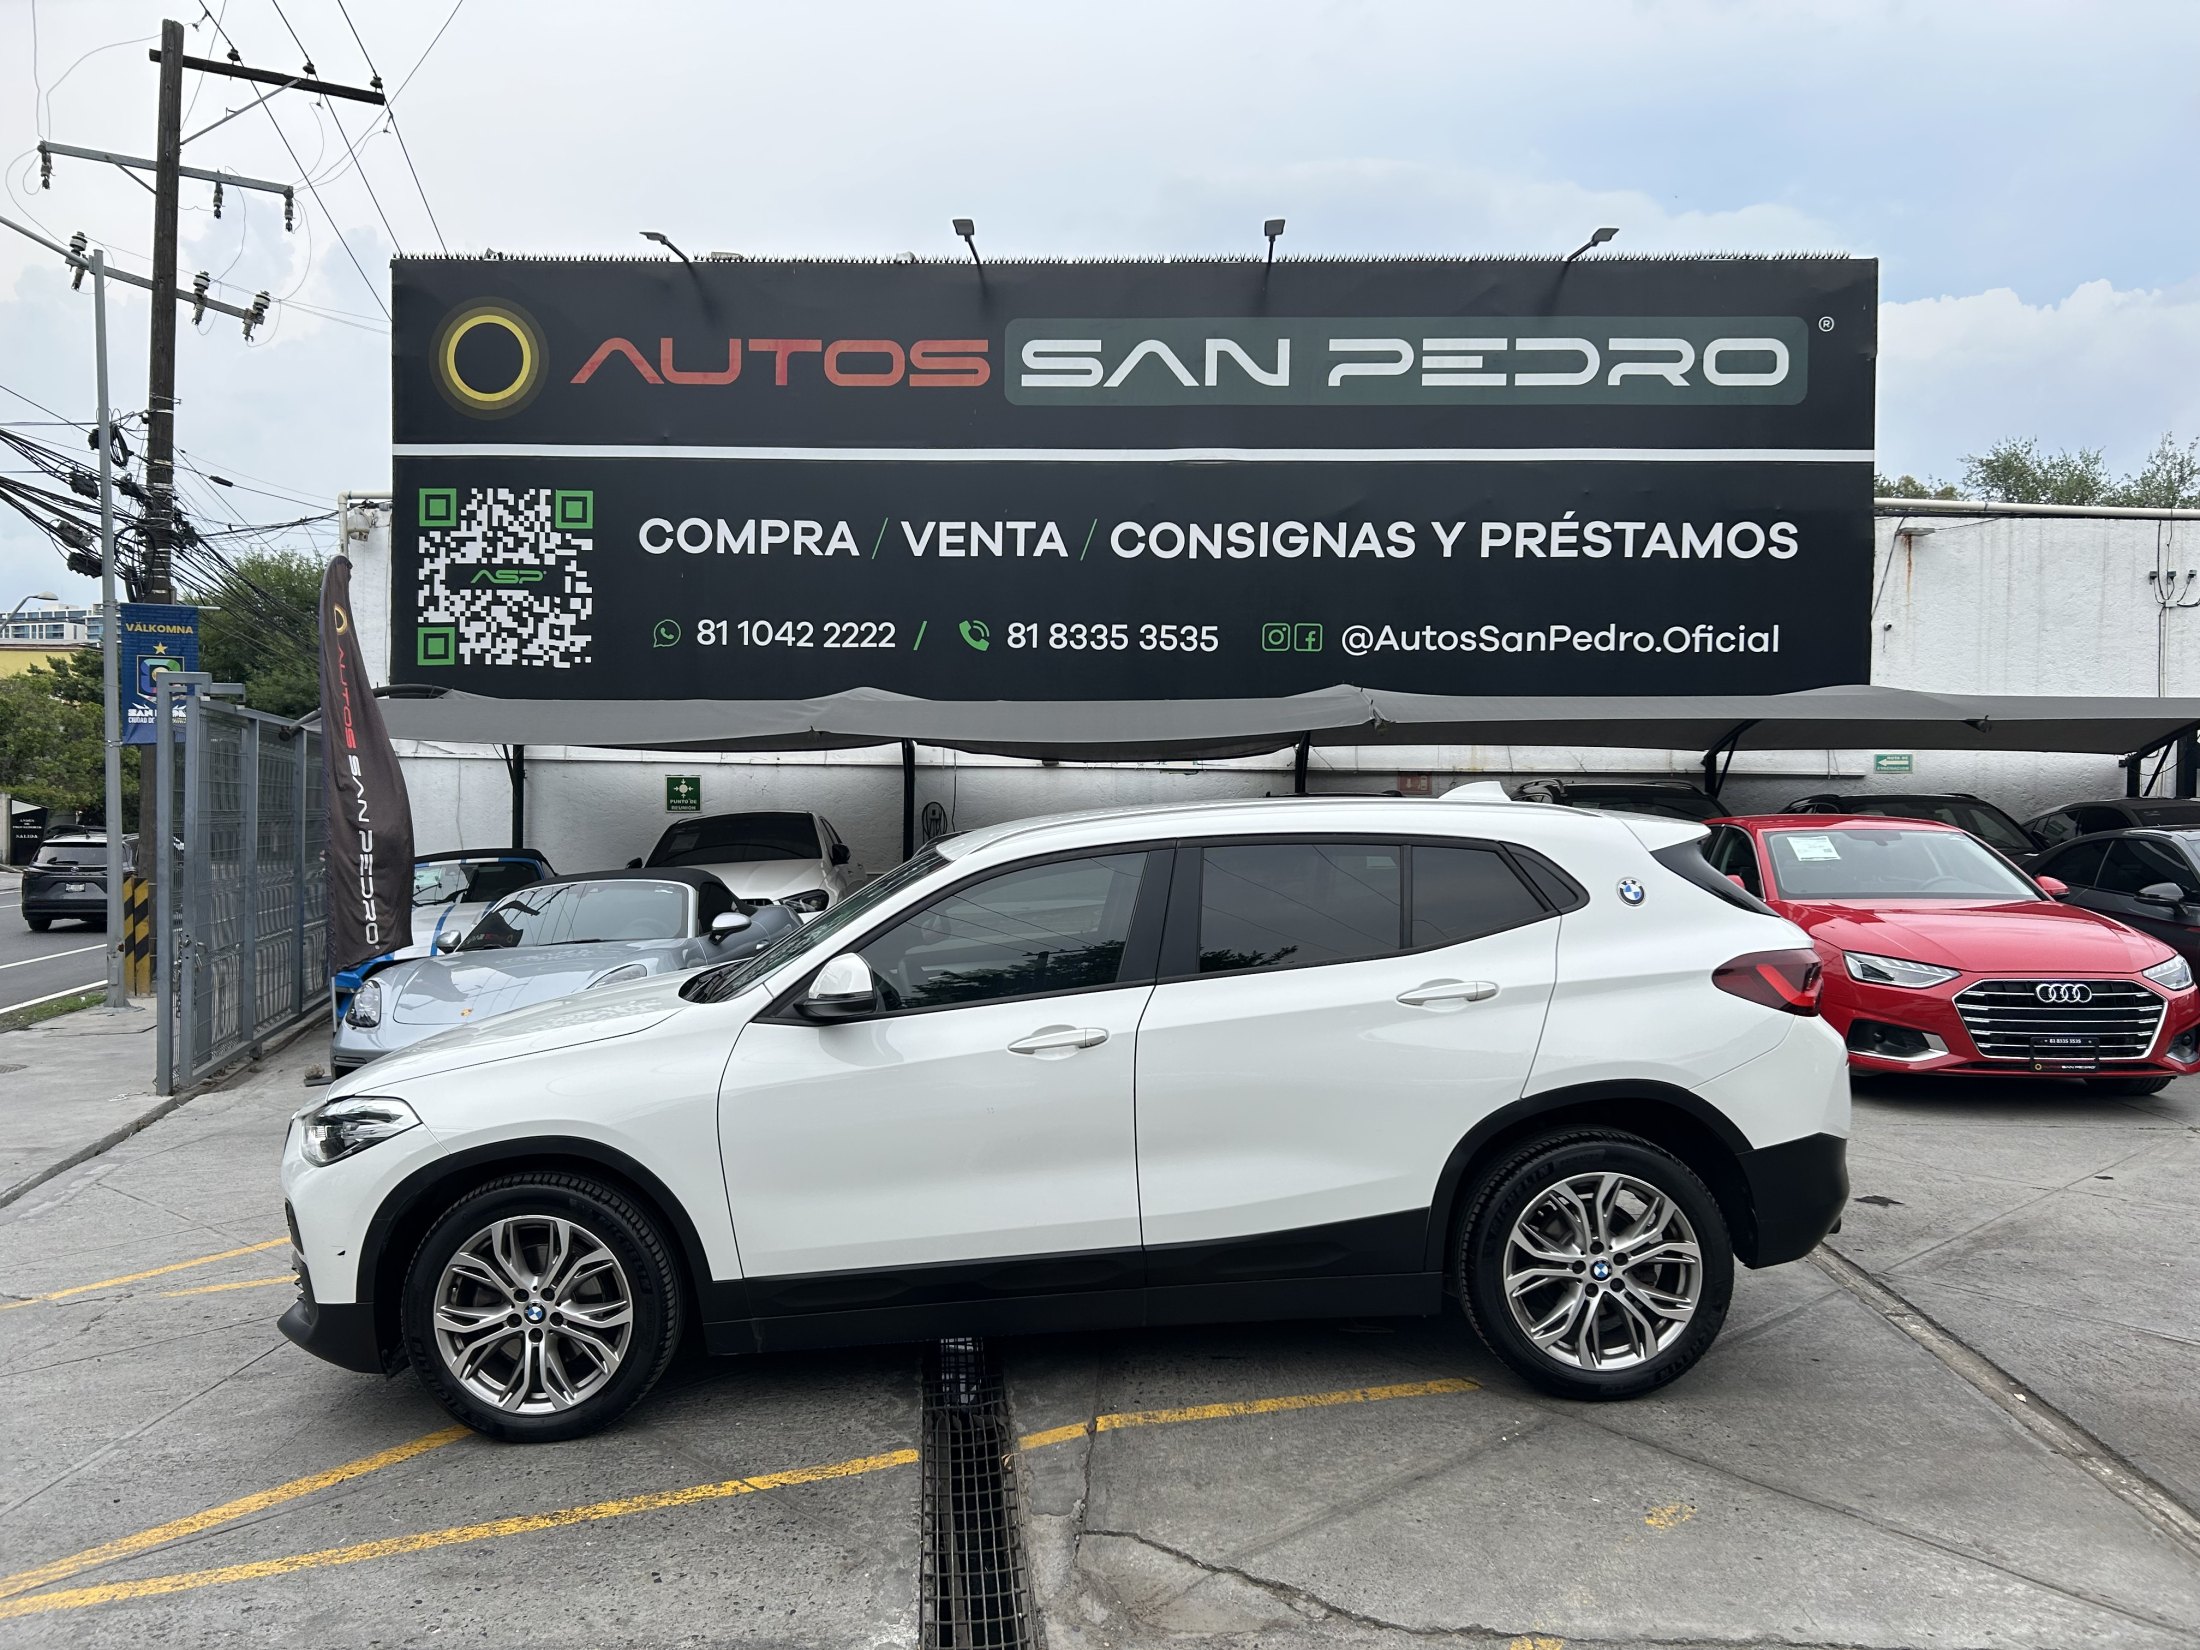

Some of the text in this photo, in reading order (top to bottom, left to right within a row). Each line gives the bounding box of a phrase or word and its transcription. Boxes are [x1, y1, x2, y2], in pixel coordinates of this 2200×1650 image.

[570, 337, 991, 387] AUTOS
[1020, 337, 1291, 388] SAN
[1327, 336, 1790, 388] PEDRO
[638, 517, 861, 557] COMPRA
[900, 520, 1069, 558] VENTA
[1110, 519, 1416, 560] CONSIGNAS
[1430, 521, 1467, 558] Y
[1480, 510, 1799, 560] PRÉSTAMOS
[470, 569, 544, 584] ASP
[125, 621, 194, 634] VÄLKOMNA
[696, 619, 728, 646] 81
[737, 619, 814, 648] 1042
[823, 621, 896, 648] 2222
[1007, 622, 1219, 652] 81 8335 3535
[1341, 622, 1780, 656] @AutosSanPedro.Oficial
[337, 647, 380, 946] AUTOS SAN PEDRO
